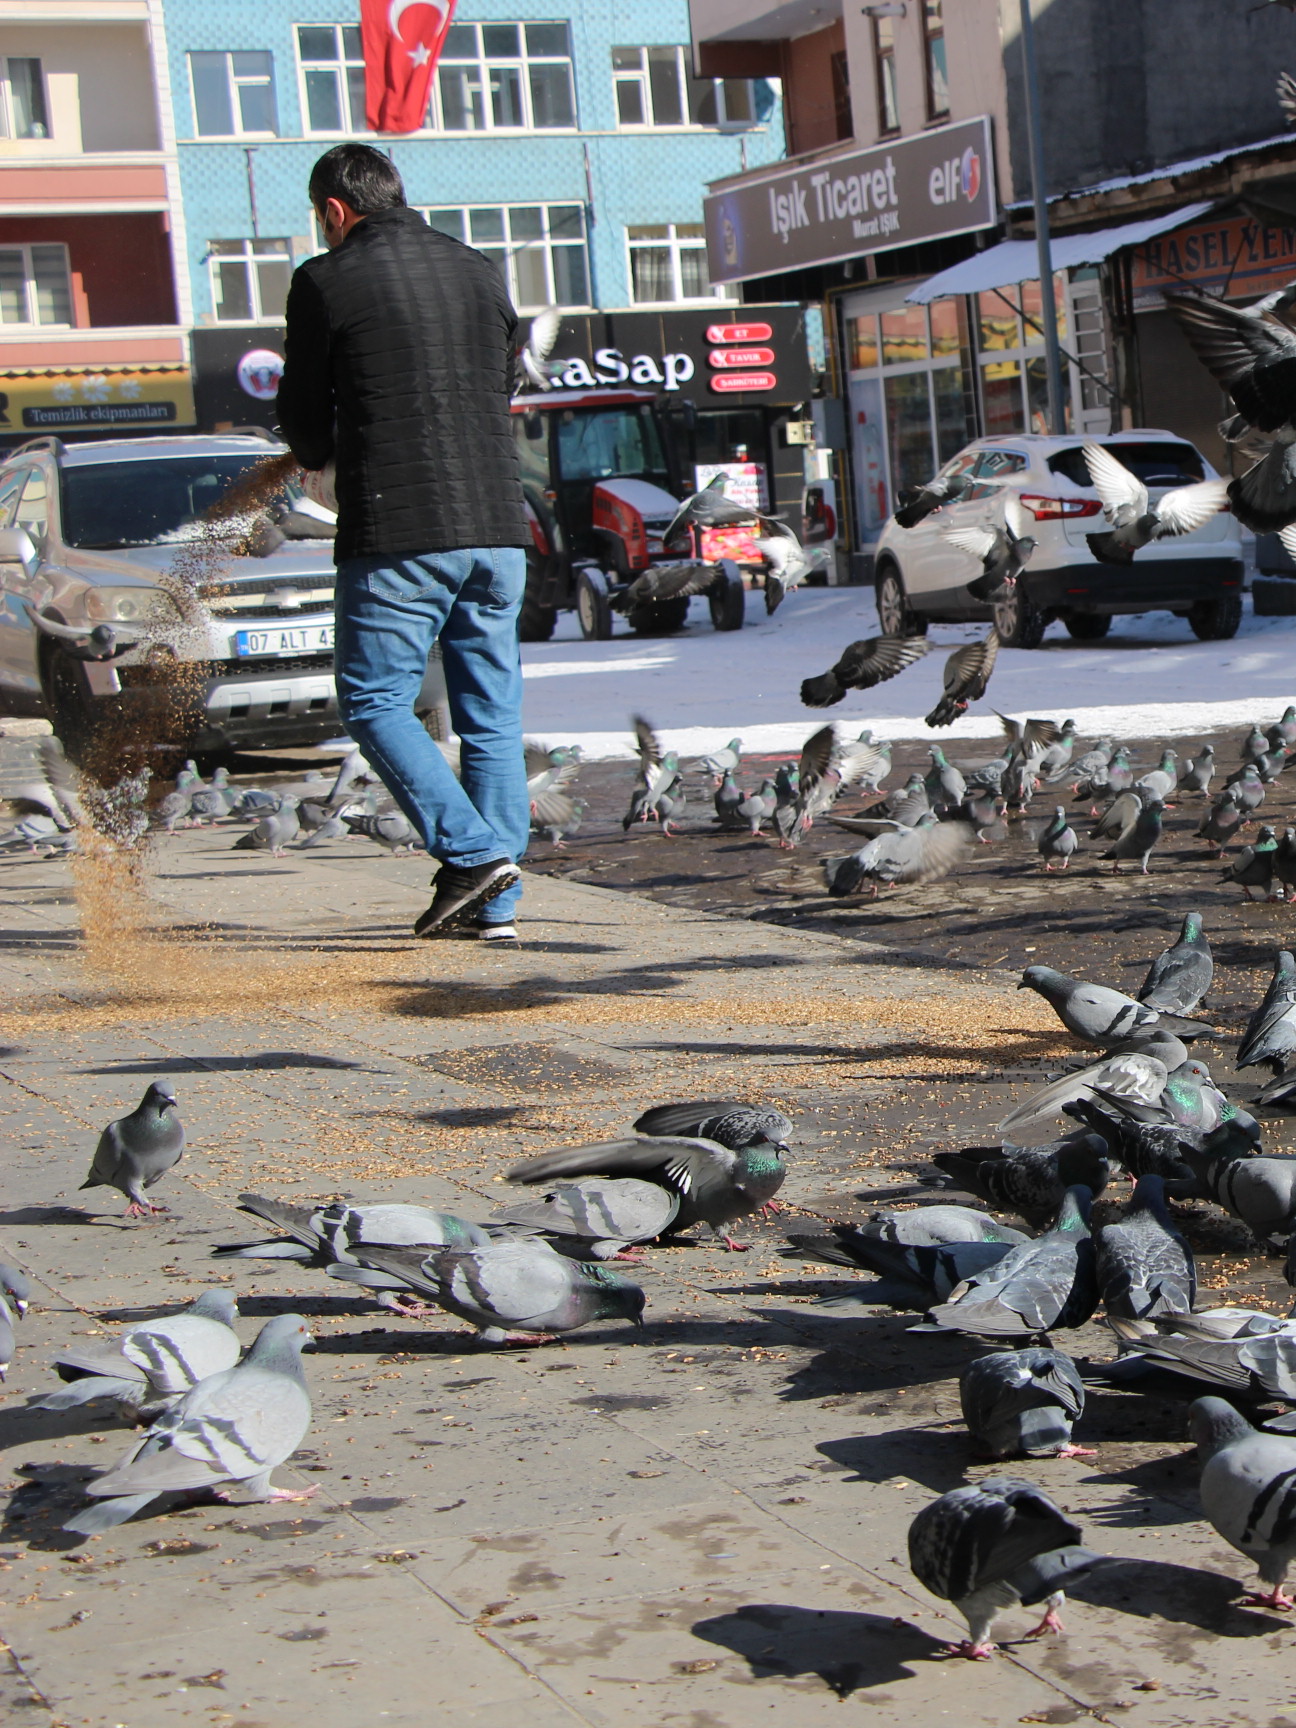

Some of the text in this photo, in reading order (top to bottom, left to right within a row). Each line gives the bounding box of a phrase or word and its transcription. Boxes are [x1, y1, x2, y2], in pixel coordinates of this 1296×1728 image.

[768, 155, 961, 245] Işık Ticaret elf
[852, 218, 880, 239] Murat
[1144, 229, 1236, 279] HASEL
[31, 403, 169, 423] Temizlik ekipmanları
[249, 633, 269, 652] 07
[280, 631, 309, 650] ALT
